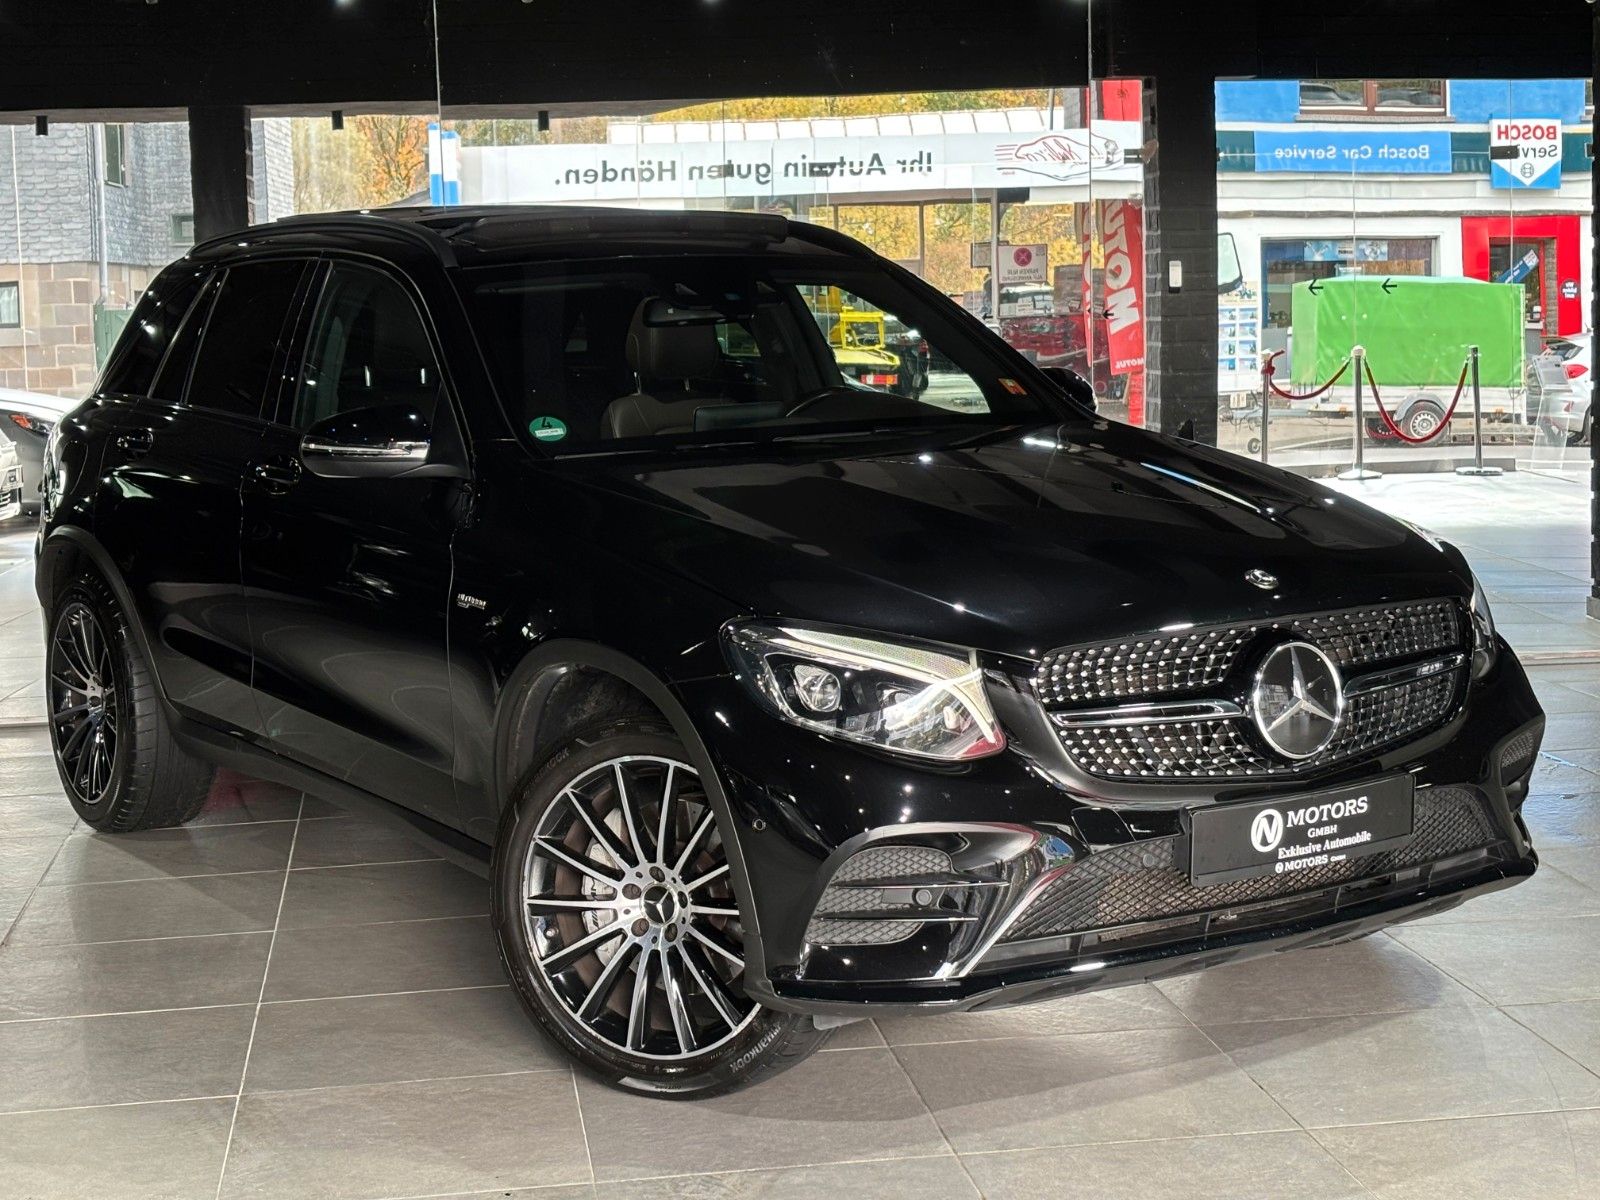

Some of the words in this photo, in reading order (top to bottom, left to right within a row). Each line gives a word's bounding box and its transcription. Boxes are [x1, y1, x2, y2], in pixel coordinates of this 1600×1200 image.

[541, 416, 552, 428] 4
[1286, 796, 1369, 828] MOTORS
[1307, 825, 1338, 838] GMBH
[1277, 841, 1322, 860] Exklusive
[1324, 831, 1372, 851] Automobile
[1284, 855, 1329, 872] MOTORS
